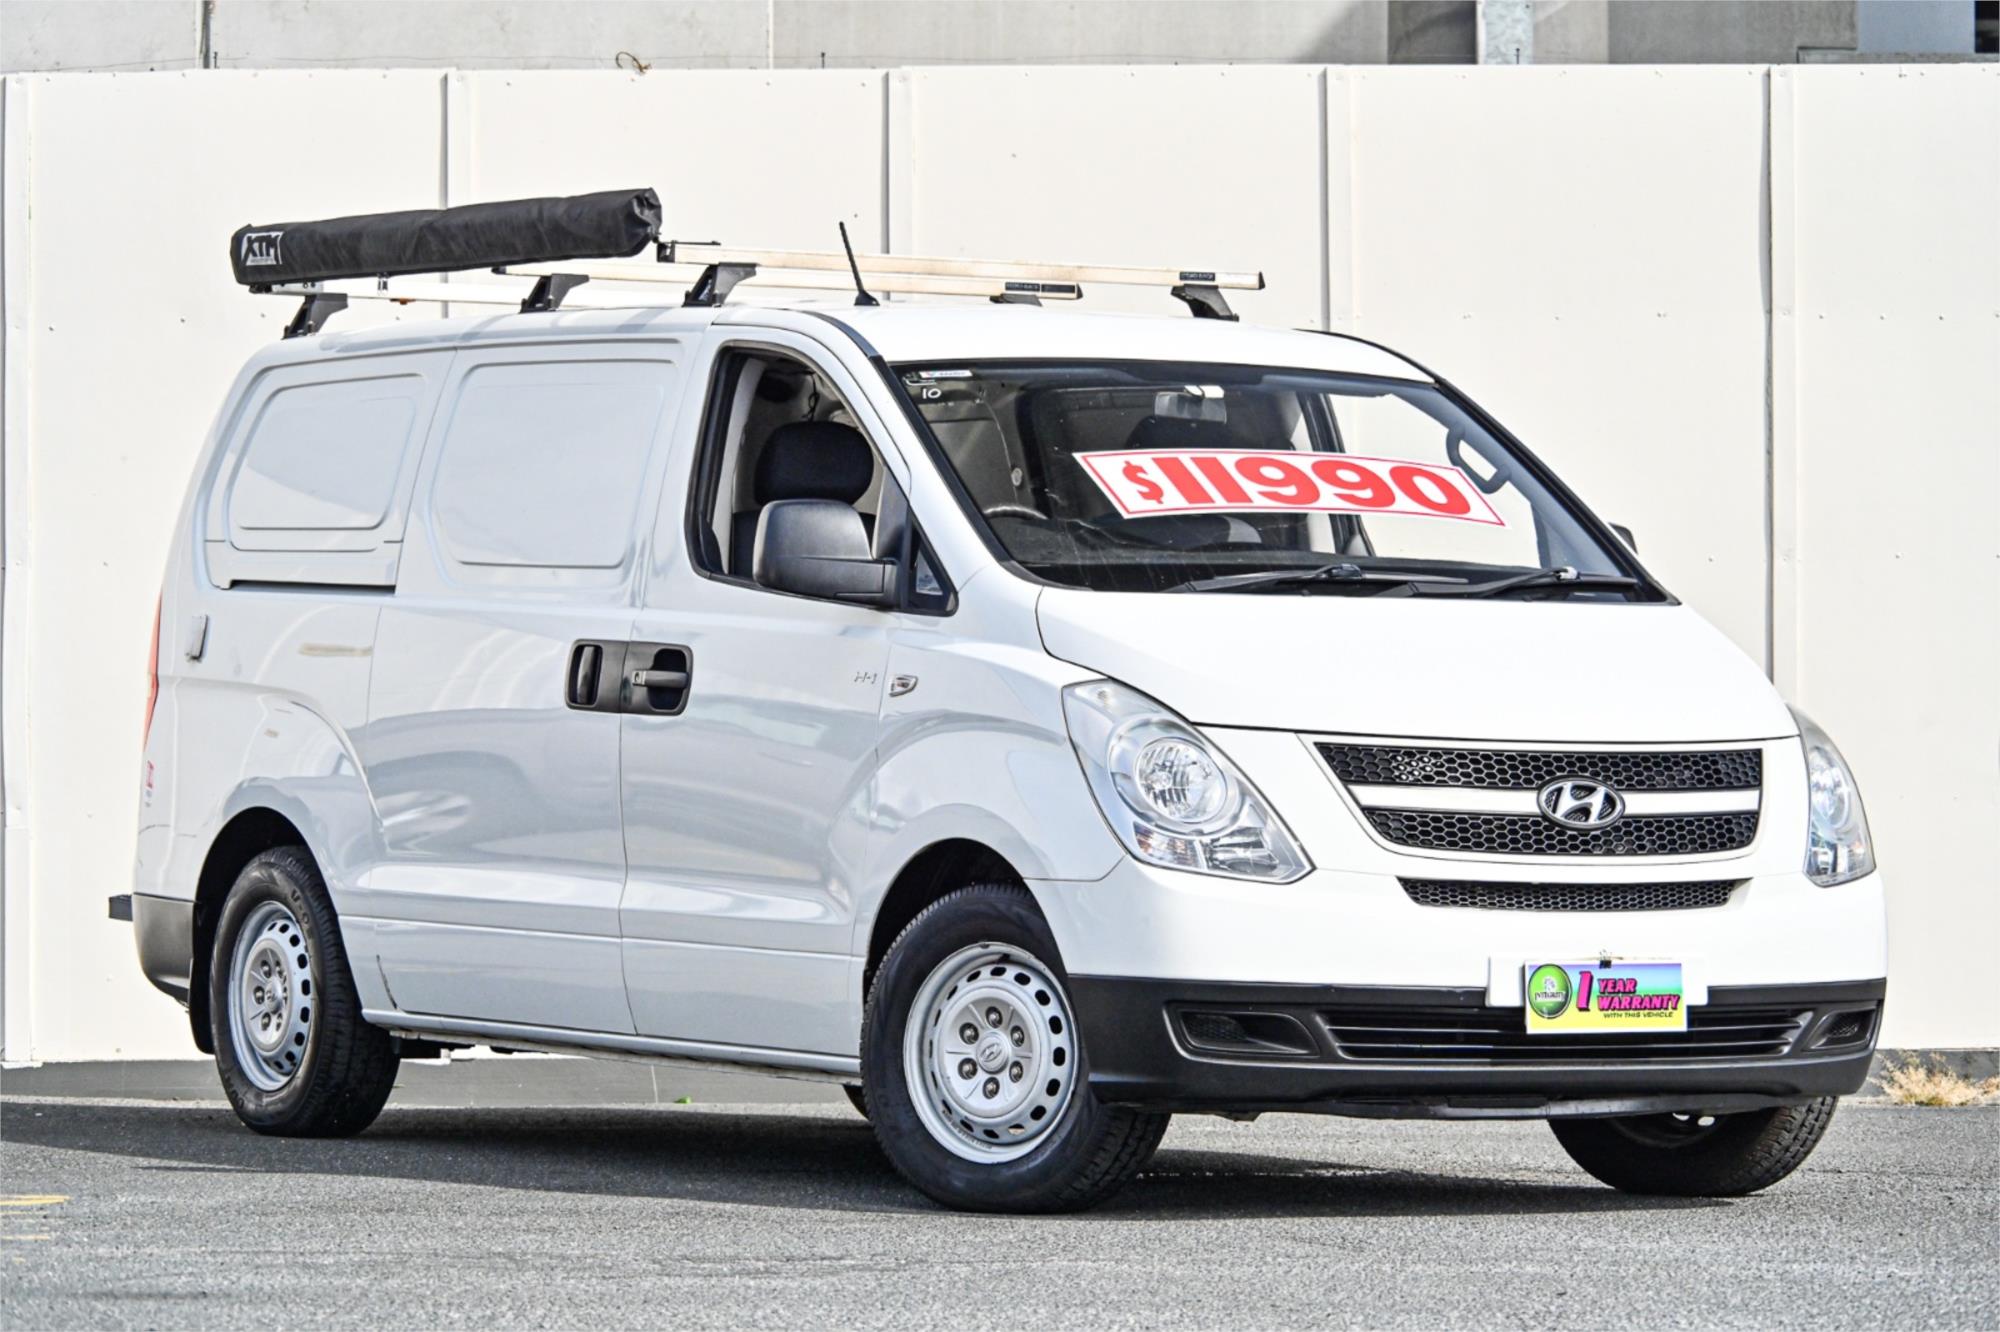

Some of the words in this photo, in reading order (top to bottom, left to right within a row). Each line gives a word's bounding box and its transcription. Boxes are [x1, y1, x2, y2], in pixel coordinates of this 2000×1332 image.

[241, 233, 282, 265] XTM
[1122, 456, 1471, 515] $11990
[1576, 970, 1594, 1012] 1
[1597, 977, 1637, 994] YEAR
[1597, 993, 1680, 1011] WARRANTY
